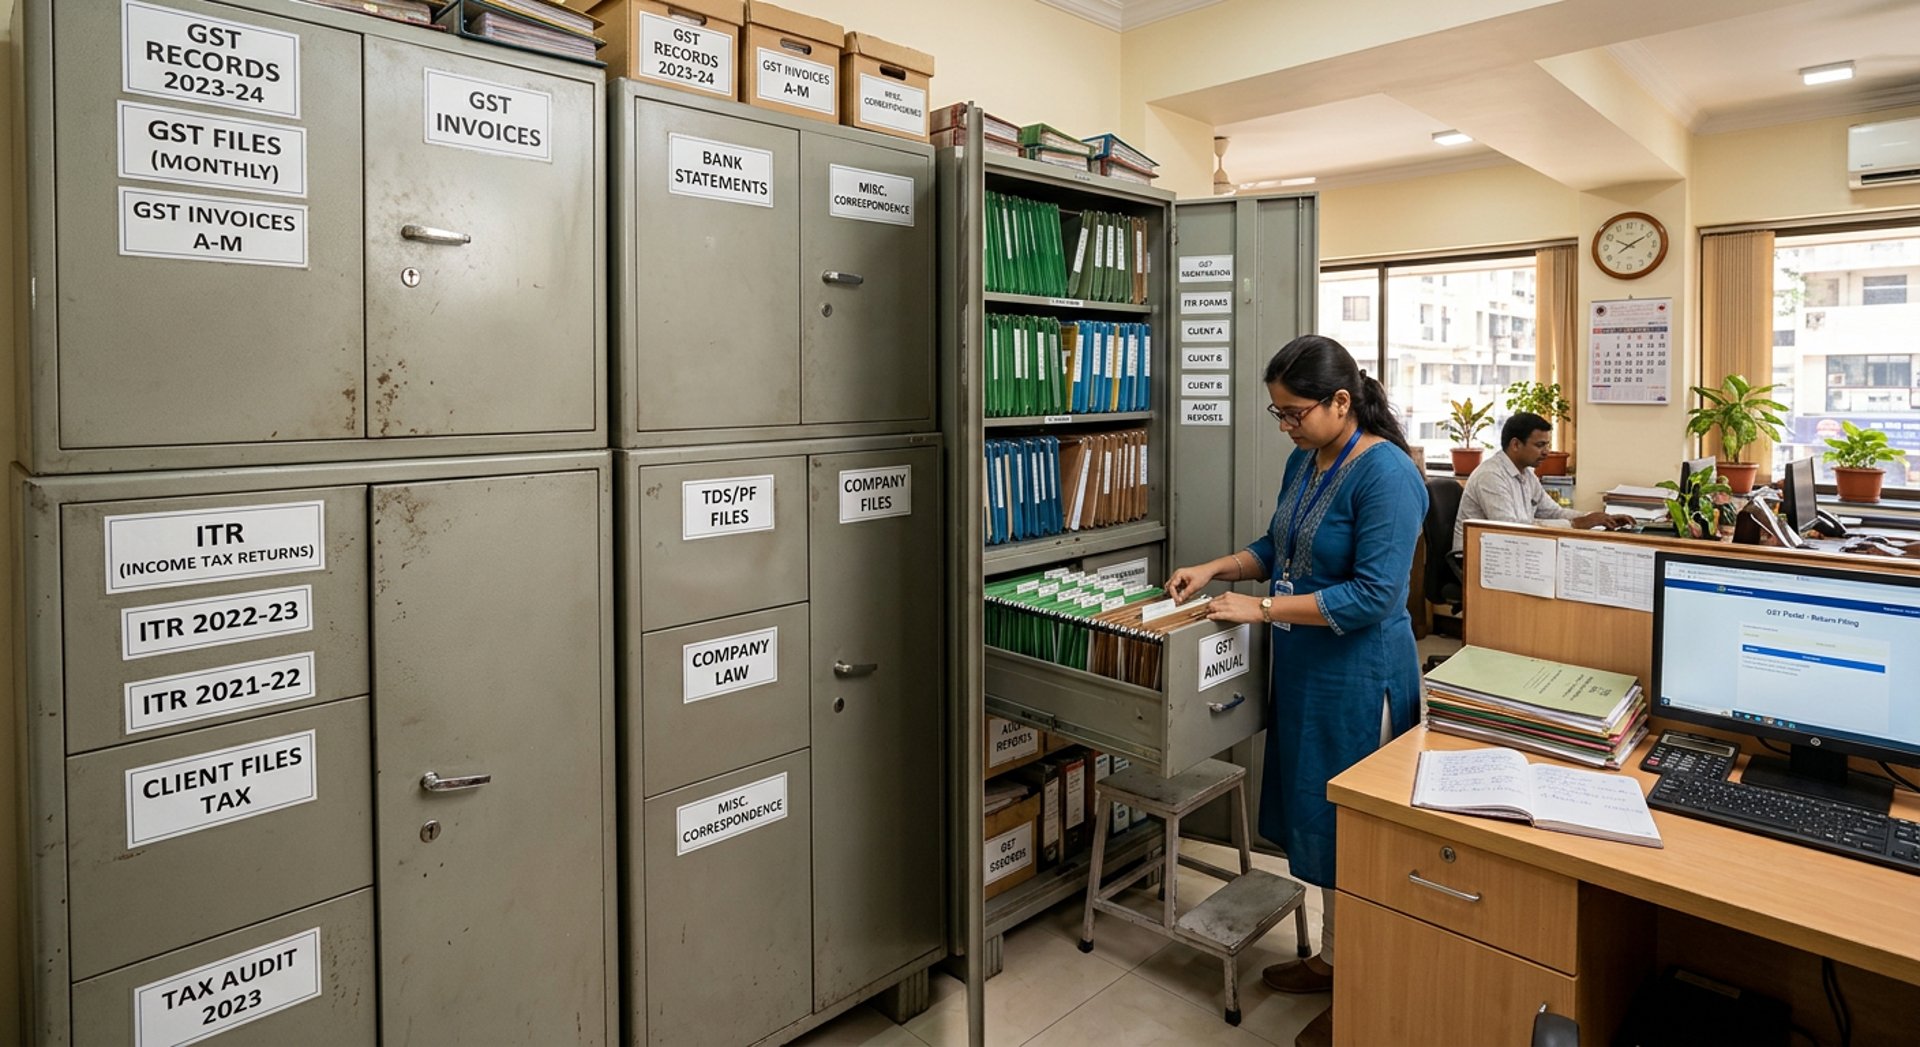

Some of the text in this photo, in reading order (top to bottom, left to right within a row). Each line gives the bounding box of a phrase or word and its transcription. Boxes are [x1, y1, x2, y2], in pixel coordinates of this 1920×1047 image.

[188, 24, 242, 49] GST
[674, 28, 700, 45] GST
[147, 41, 280, 83] RECORDS
[654, 41, 718, 68] RECORDS
[763, 60, 782, 73] GST
[659, 61, 714, 85] 2023-24
[164, 72, 264, 103] 2023-24
[784, 82, 809, 98] A-M
[470, 92, 512, 114] GST
[148, 120, 281, 155] GST FILES
[438, 113, 541, 147] INVOICES
[152, 151, 279, 184] (MONTHLY)
[703, 151, 742, 170] BANK
[676, 169, 768, 195] STATEMENTS
[859, 182, 887, 197] MISC.
[134, 202, 295, 231] GST INVOICES
[194, 233, 242, 252] A-M
[702, 486, 757, 505] TDS/PF
[844, 474, 906, 494] COMPANY
[862, 496, 892, 512] FILES
[712, 510, 749, 527] FILES
[198, 523, 244, 547] ITR
[120, 544, 314, 579] (INCOME TAX RETURNS)
[140, 601, 298, 642] ITR 2022-23
[693, 639, 769, 668] COMPANY
[1216, 638, 1234, 655] GST
[716, 665, 749, 685] LAW
[1205, 654, 1244, 679] ANNUAL
[144, 669, 301, 715] ITR 2021-22
[143, 748, 302, 798] CLIENT FILES
[200, 787, 251, 814] TAX
[718, 796, 748, 814] MISC.
[683, 799, 782, 843] CORRESPONDENCE
[162, 948, 297, 1011] TAX AUDIT
[202, 989, 262, 1026] 2023
